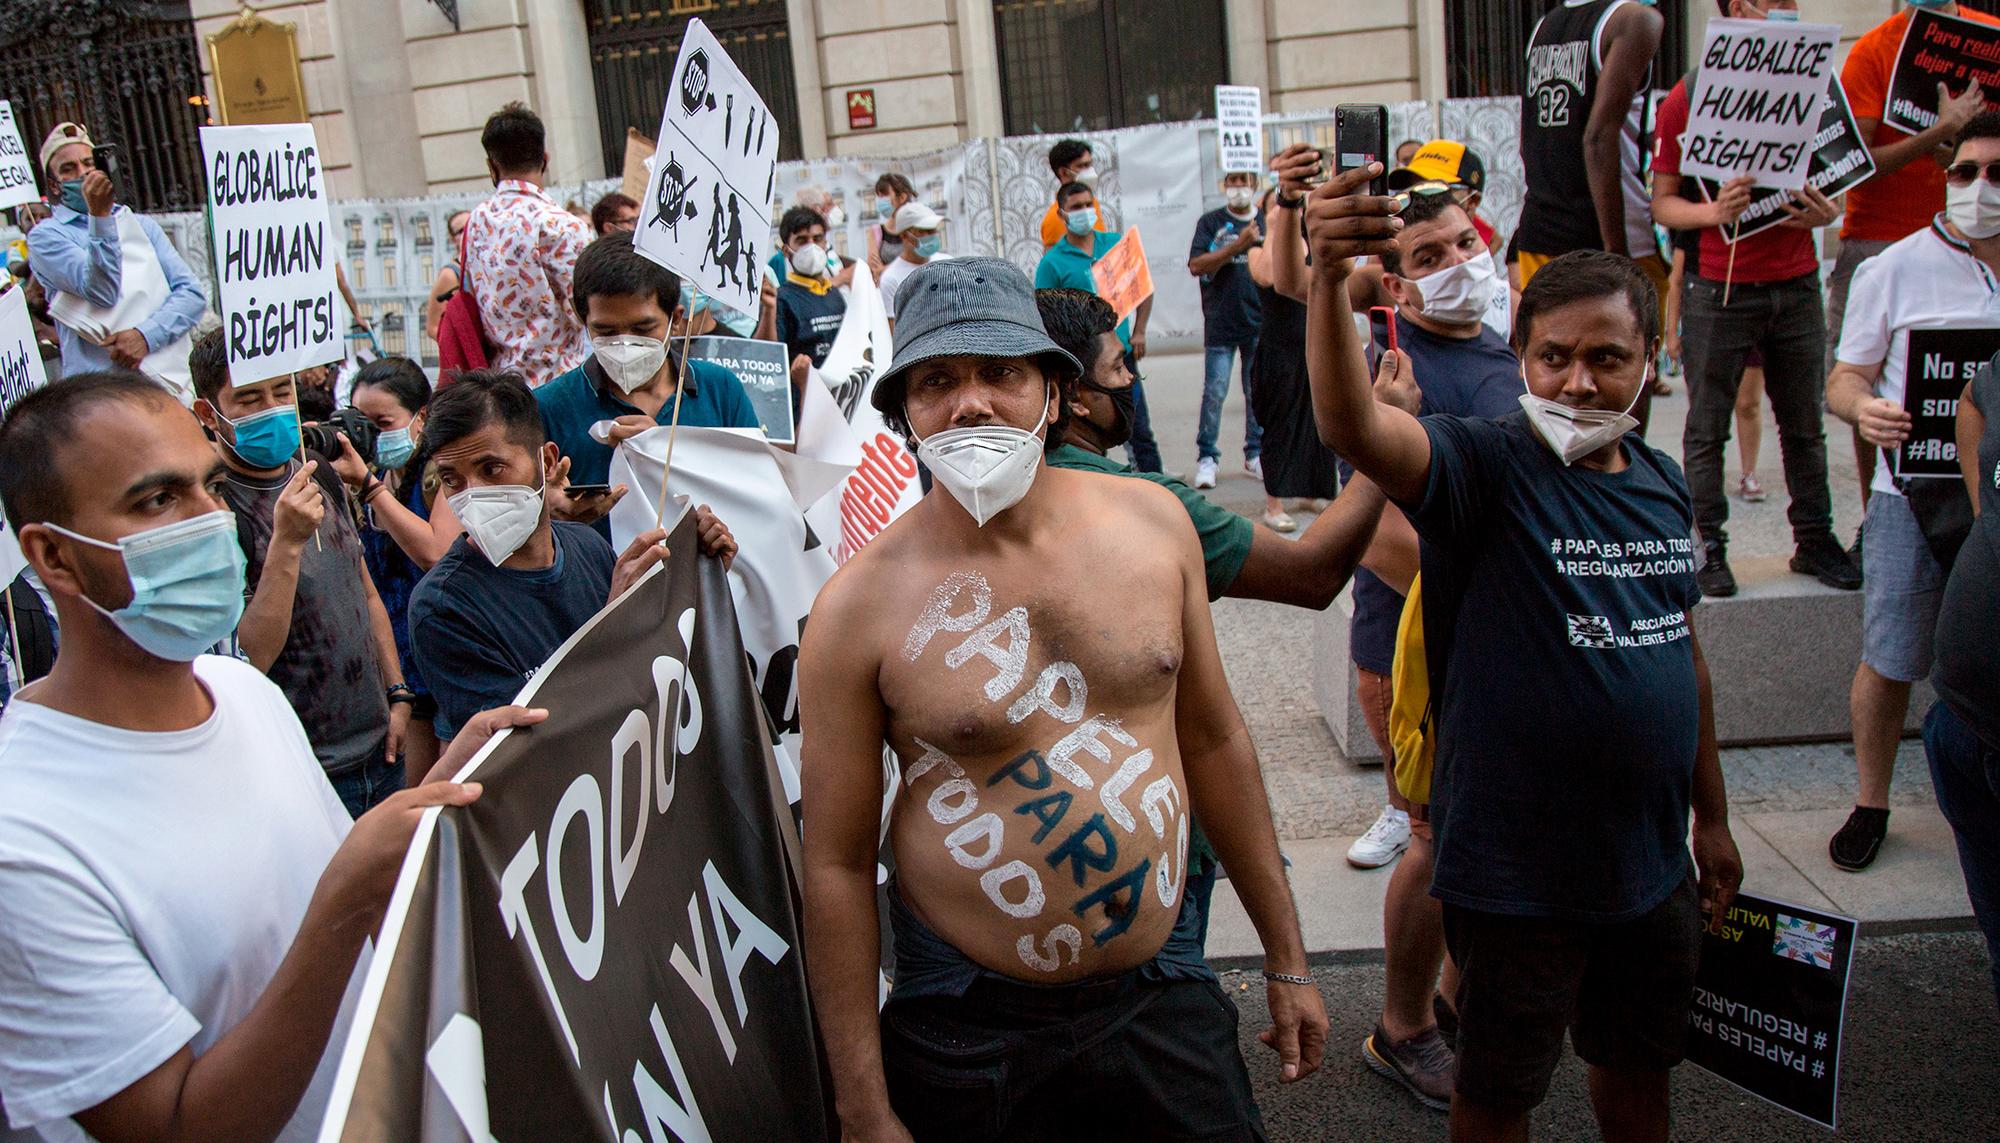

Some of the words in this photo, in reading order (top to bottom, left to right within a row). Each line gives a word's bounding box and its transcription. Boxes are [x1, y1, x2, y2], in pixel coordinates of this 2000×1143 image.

[1923, 21, 1962, 49] Para
[683, 59, 707, 101] STOP
[1914, 47, 1955, 74] dejar
[1955, 64, 1967, 78] a
[1538, 84, 1569, 127] 92
[1697, 84, 1816, 126] HUMAN
[225, 221, 323, 283] HUMAN
[742, 359, 783, 373] TODOS
[759, 374, 775, 385] YA
[1923, 353, 1955, 380] No
[1625, 540, 1667, 557] PARA
[902, 570, 1188, 908] PAPELES
[905, 736, 1082, 973] TODOS
[987, 749, 1151, 948] PARA
[669, 859, 790, 1066] YA
[1718, 1022, 1806, 1073] PAPELES
